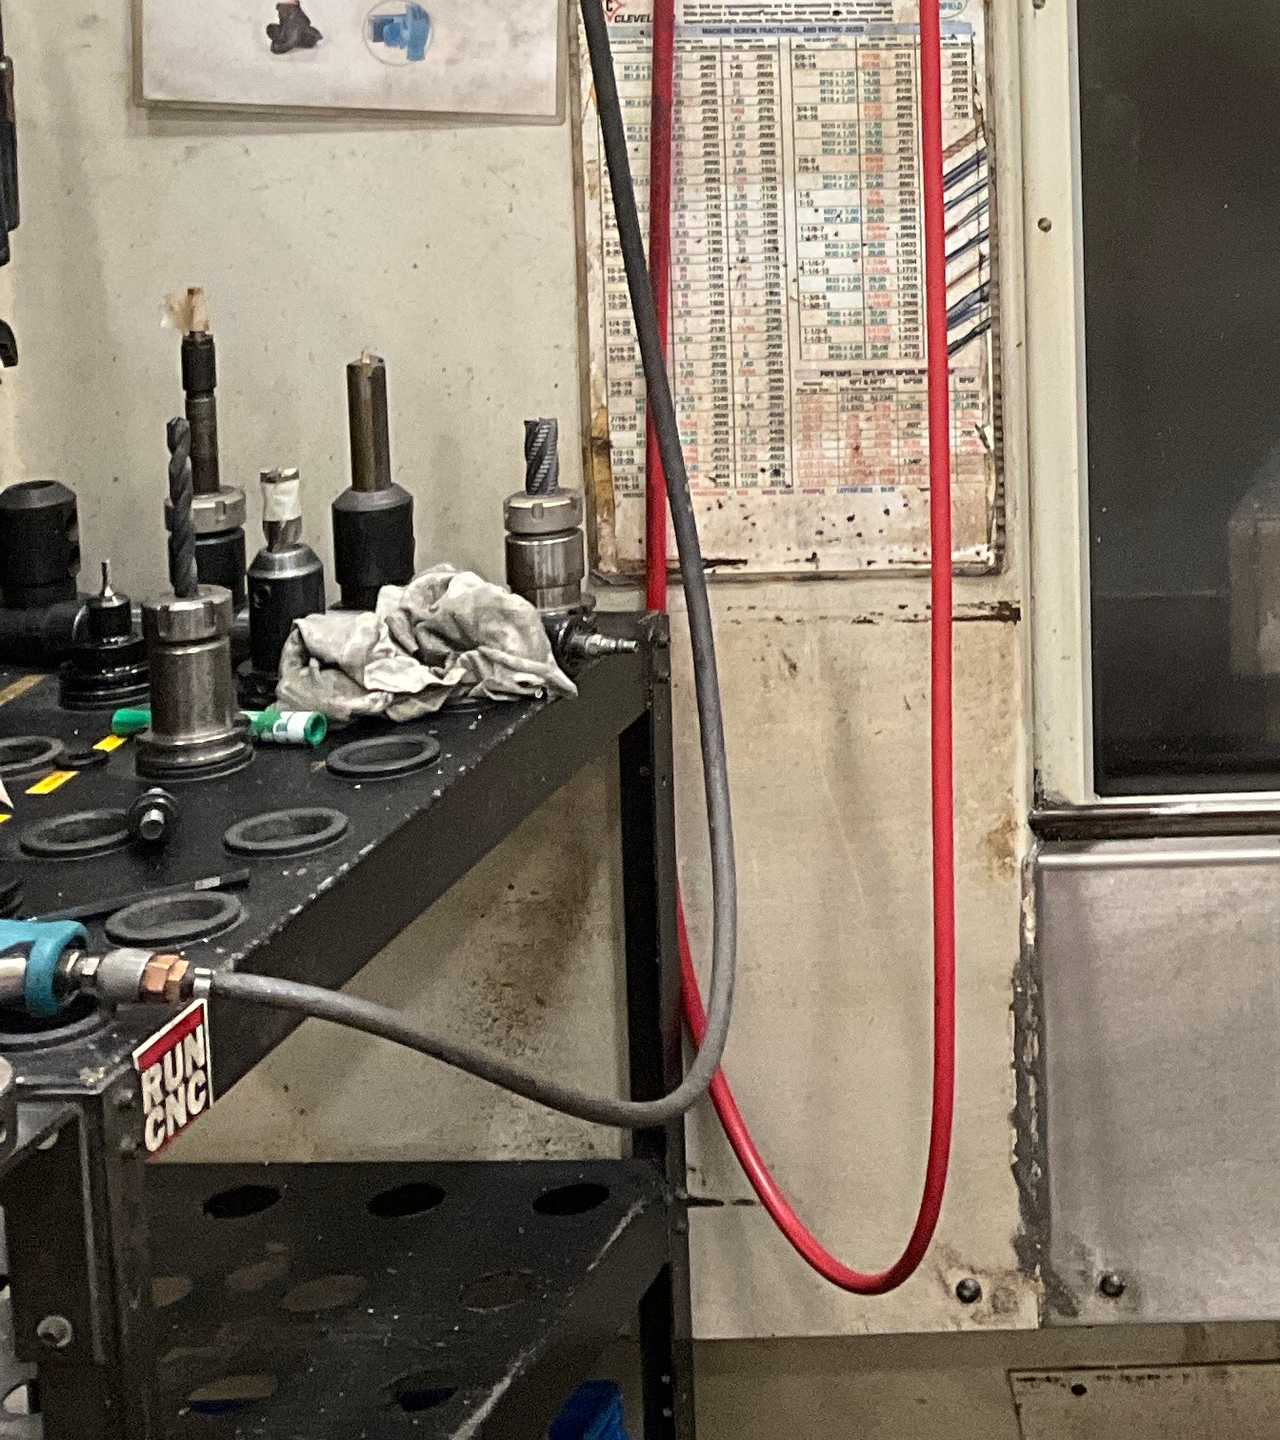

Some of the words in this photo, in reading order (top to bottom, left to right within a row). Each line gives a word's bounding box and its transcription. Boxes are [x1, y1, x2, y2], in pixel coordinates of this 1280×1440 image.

[605, 0, 613, 13] C
[614, 14, 653, 24] CLEVEL
[141, 1024, 206, 1113] RUN
[144, 1069, 208, 1153] CNC
